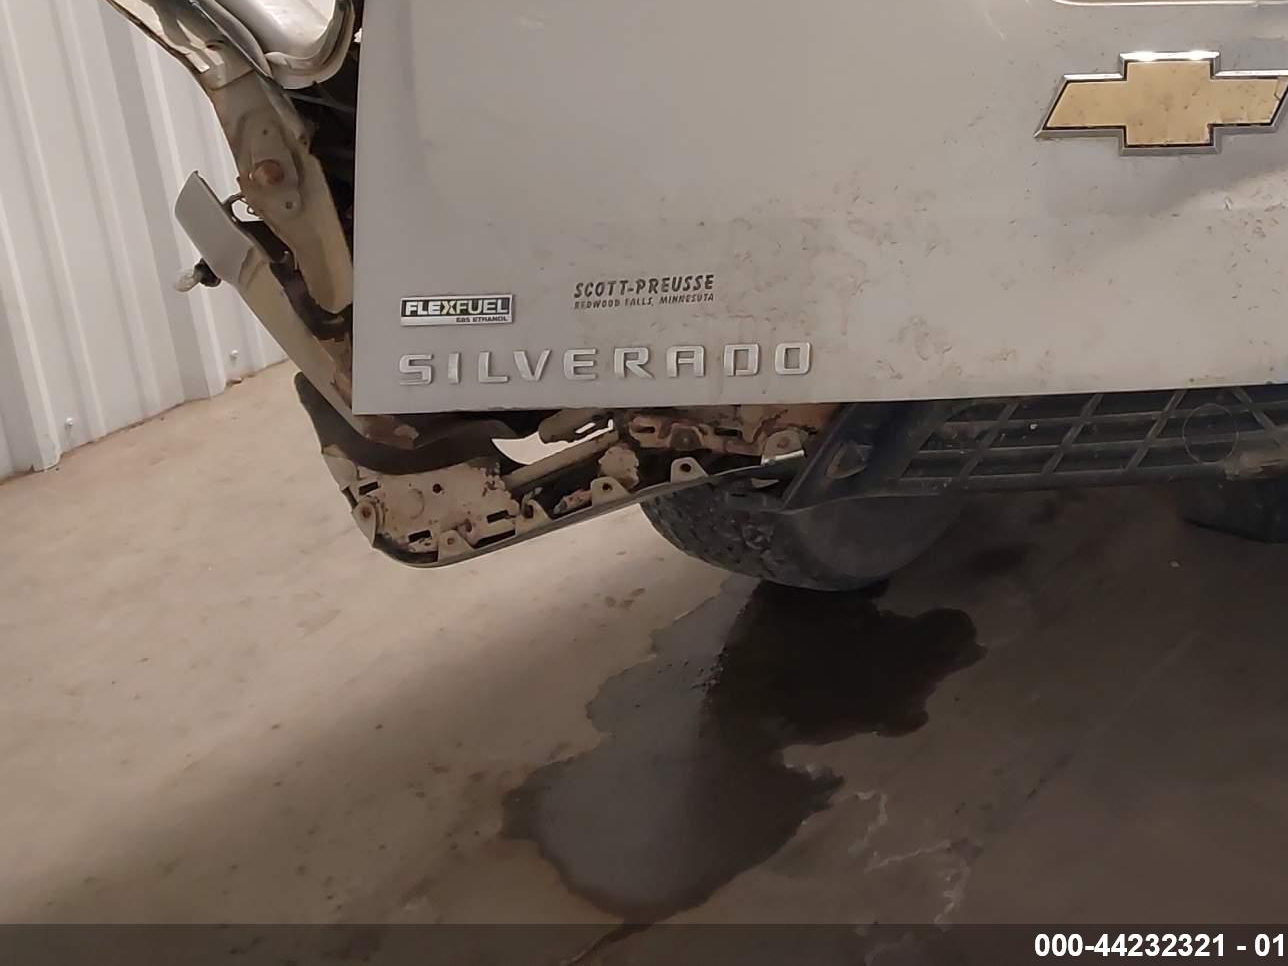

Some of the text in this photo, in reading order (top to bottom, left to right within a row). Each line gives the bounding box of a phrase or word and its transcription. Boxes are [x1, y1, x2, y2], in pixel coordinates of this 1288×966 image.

[573, 275, 714, 298] SCOTT-PREUSSE
[405, 299, 509, 316] FLEXFUEL
[574, 298, 620, 309] REDWOOD
[399, 342, 812, 386] SILVERADO
